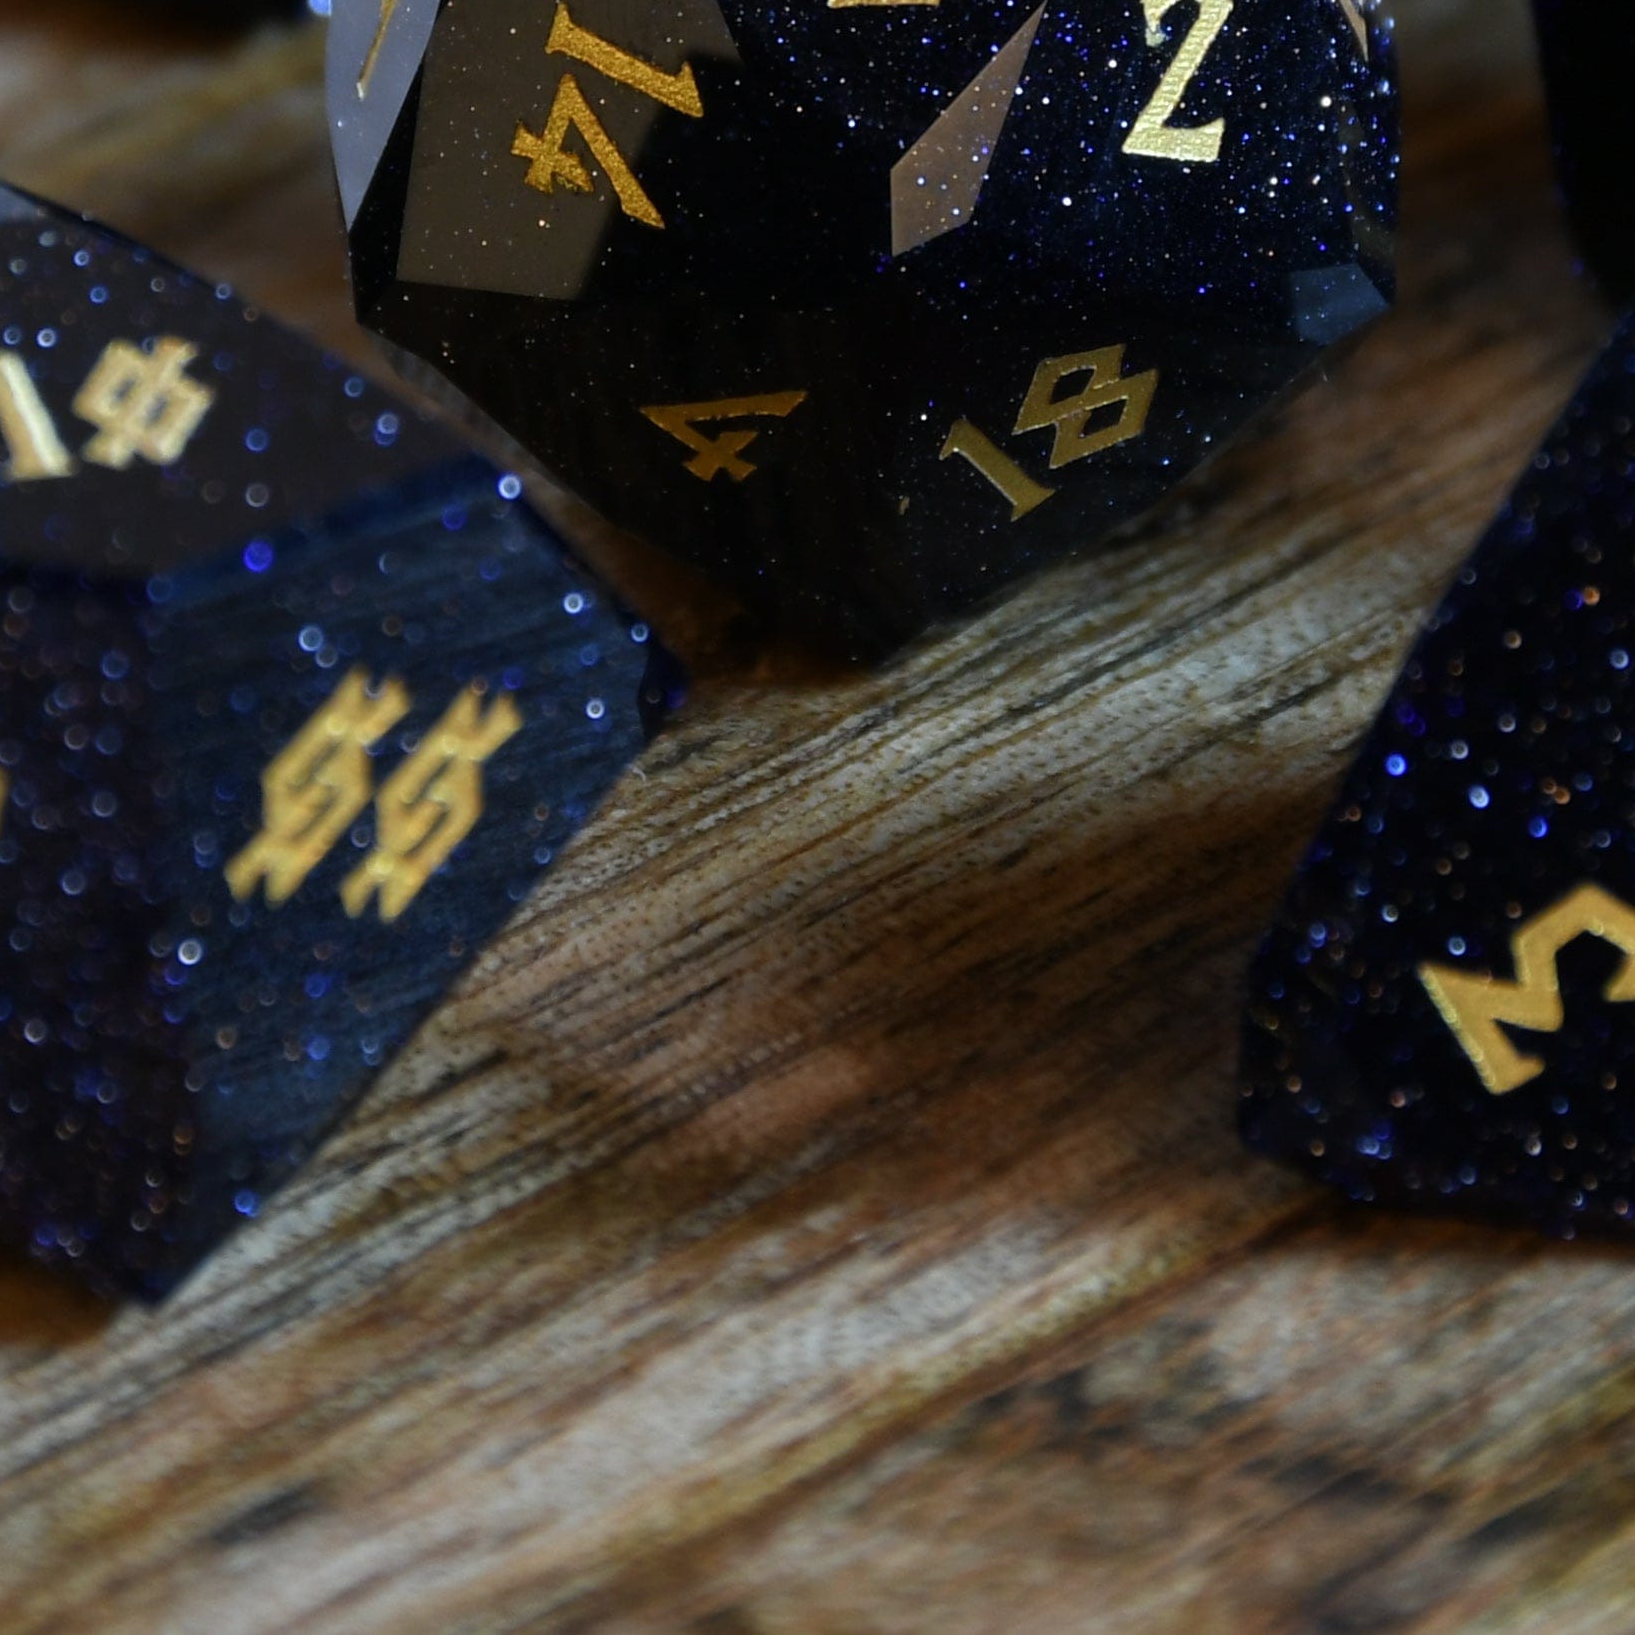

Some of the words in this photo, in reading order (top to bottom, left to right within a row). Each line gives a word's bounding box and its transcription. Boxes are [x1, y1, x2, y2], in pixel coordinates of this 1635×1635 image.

[510, 0, 705, 229] 14
[639, 388, 808, 483] 4
[938, 343, 1160, 522] 18
